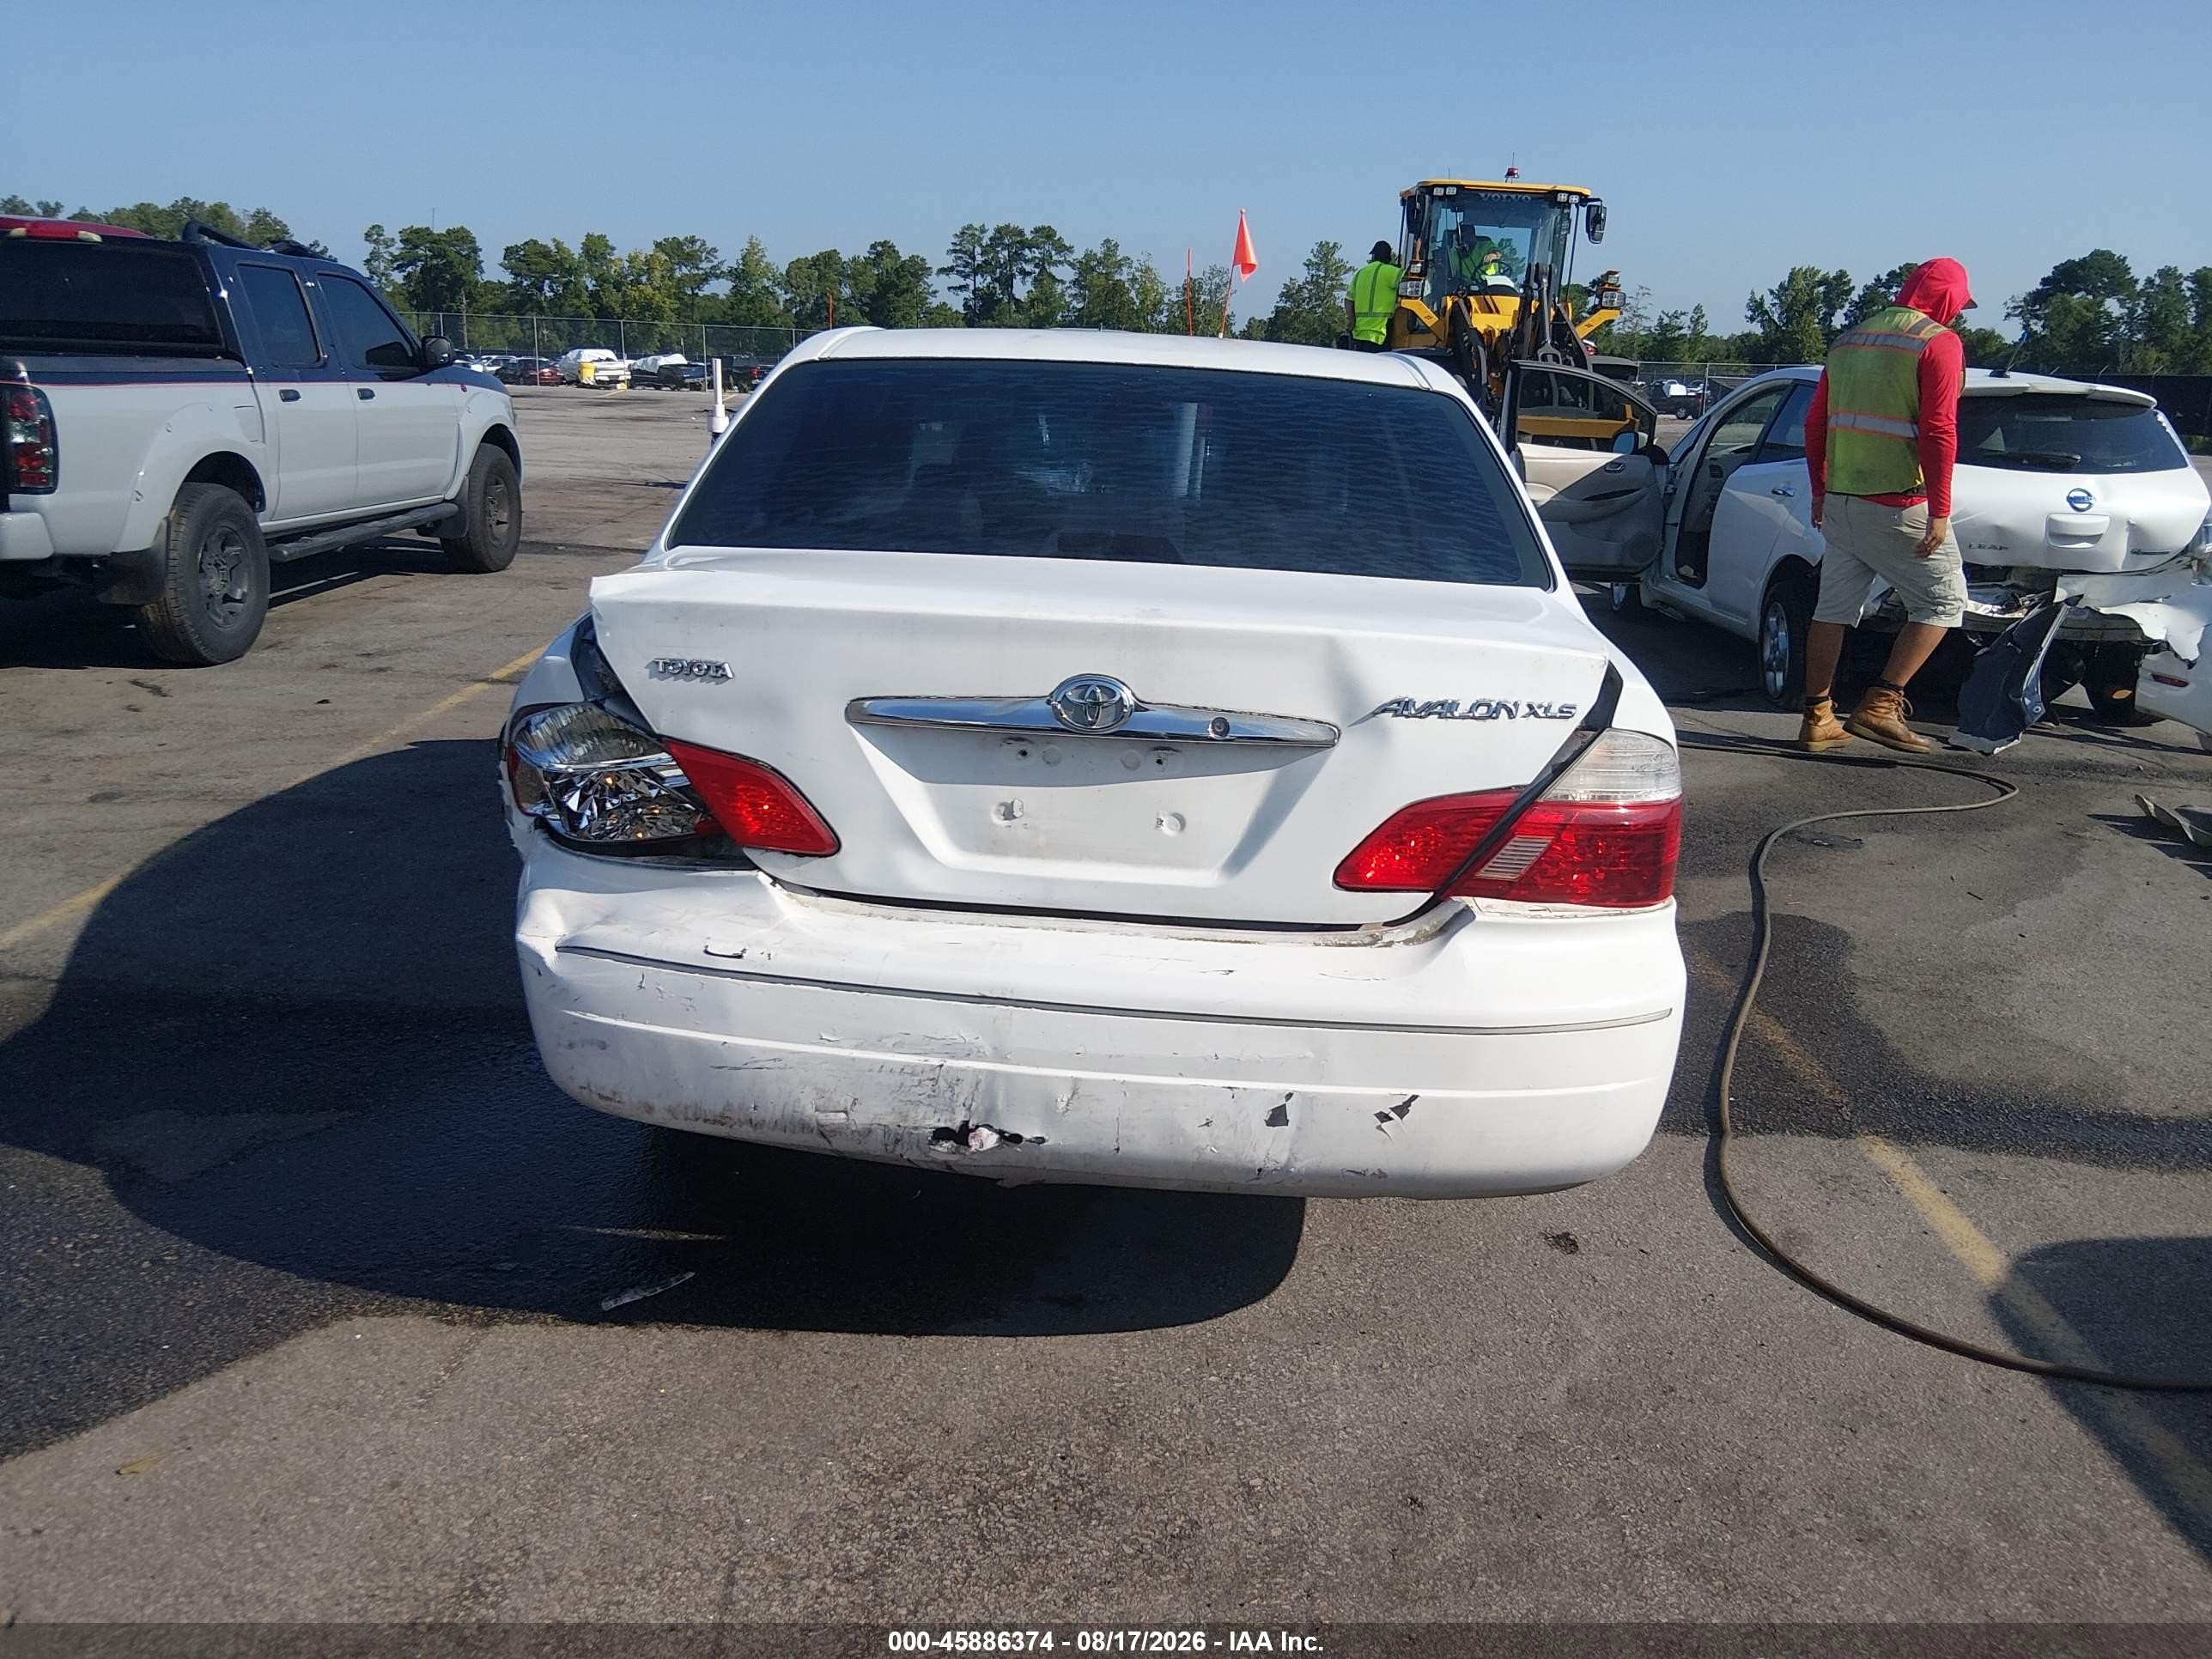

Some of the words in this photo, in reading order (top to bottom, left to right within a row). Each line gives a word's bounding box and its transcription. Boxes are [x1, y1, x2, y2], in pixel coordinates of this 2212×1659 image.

[653, 658, 734, 679] TOYOTA
[1370, 696, 1519, 720] AVALON
[1521, 702, 1577, 720] XLS
